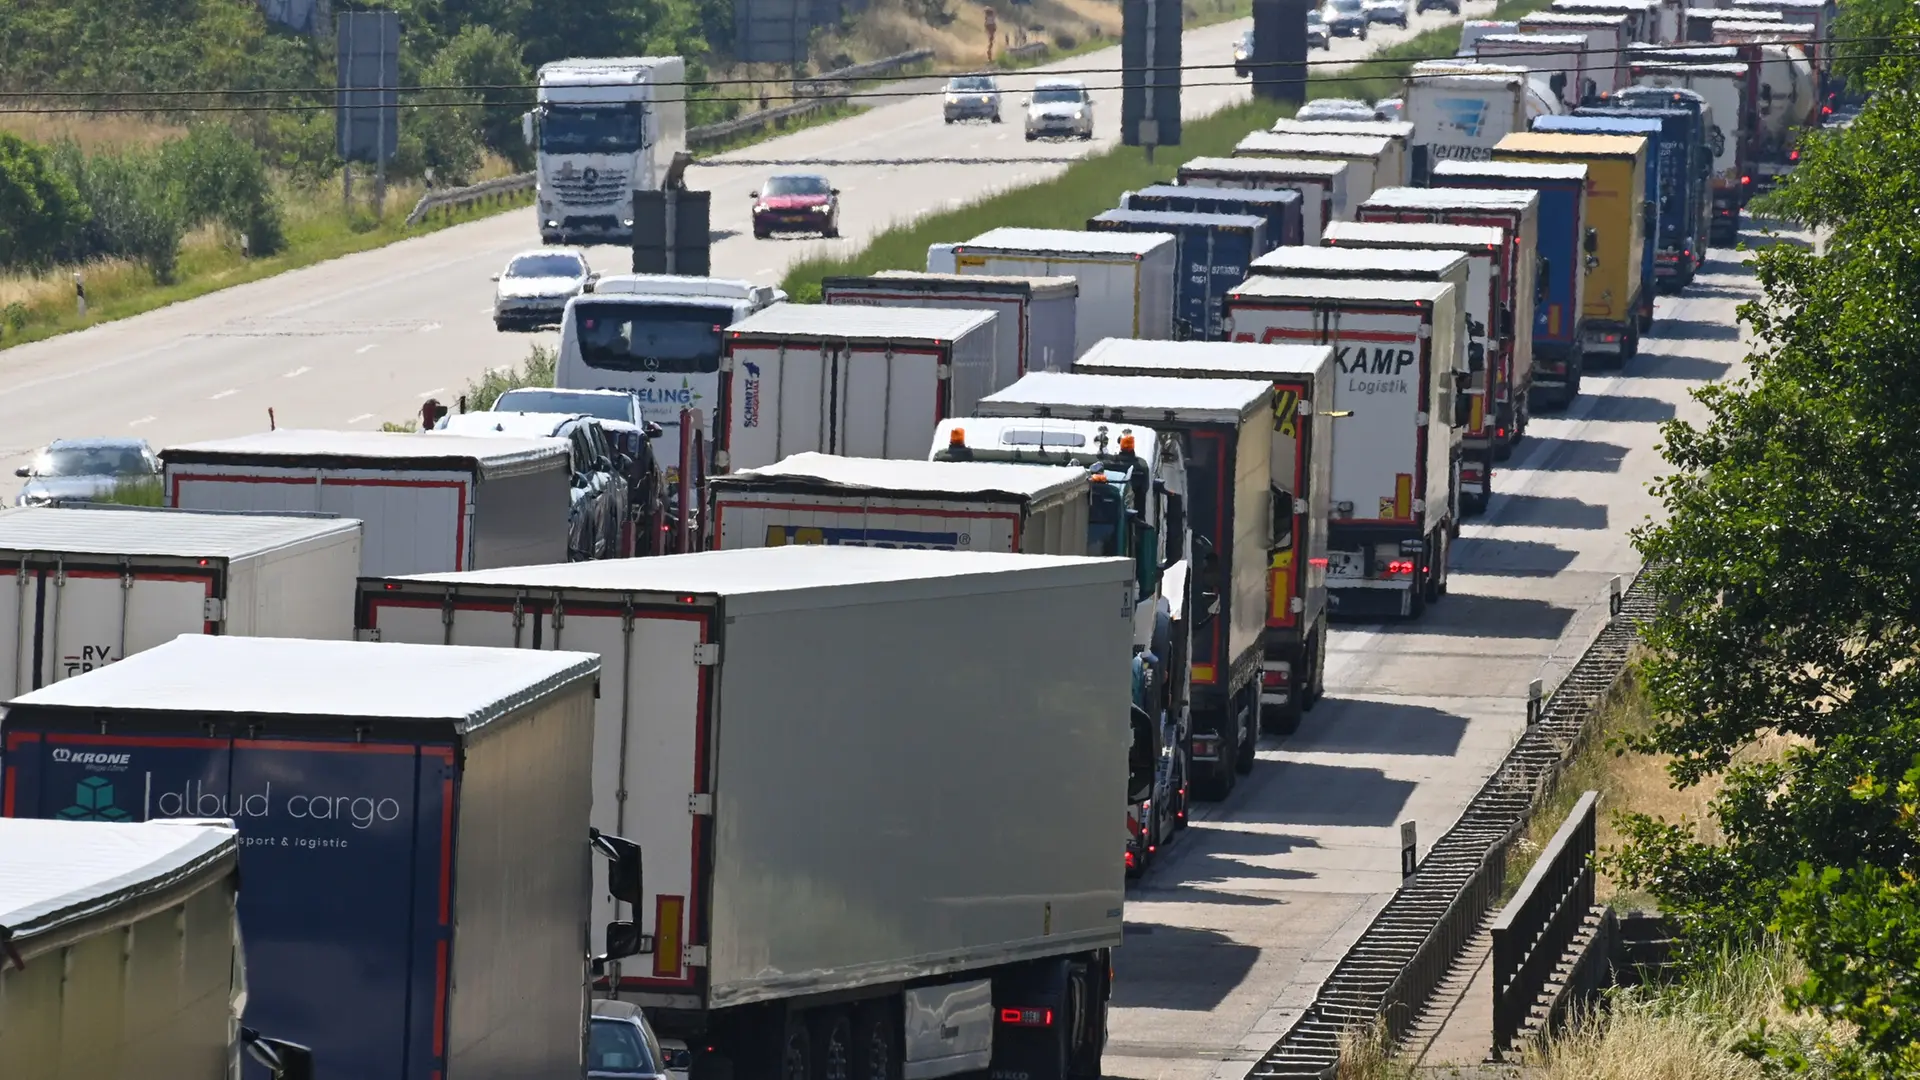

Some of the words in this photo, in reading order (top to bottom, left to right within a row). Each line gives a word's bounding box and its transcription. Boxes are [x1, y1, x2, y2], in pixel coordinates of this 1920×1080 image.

[1333, 346, 1415, 375] KAMP
[1349, 380, 1408, 395] Logistik
[82, 645, 111, 661] RV
[71, 753, 131, 764] KRONE
[158, 779, 271, 817] albud
[287, 796, 400, 830] cargo
[238, 836, 276, 848] sport
[281, 837, 289, 847] &
[294, 837, 348, 849] logistic
